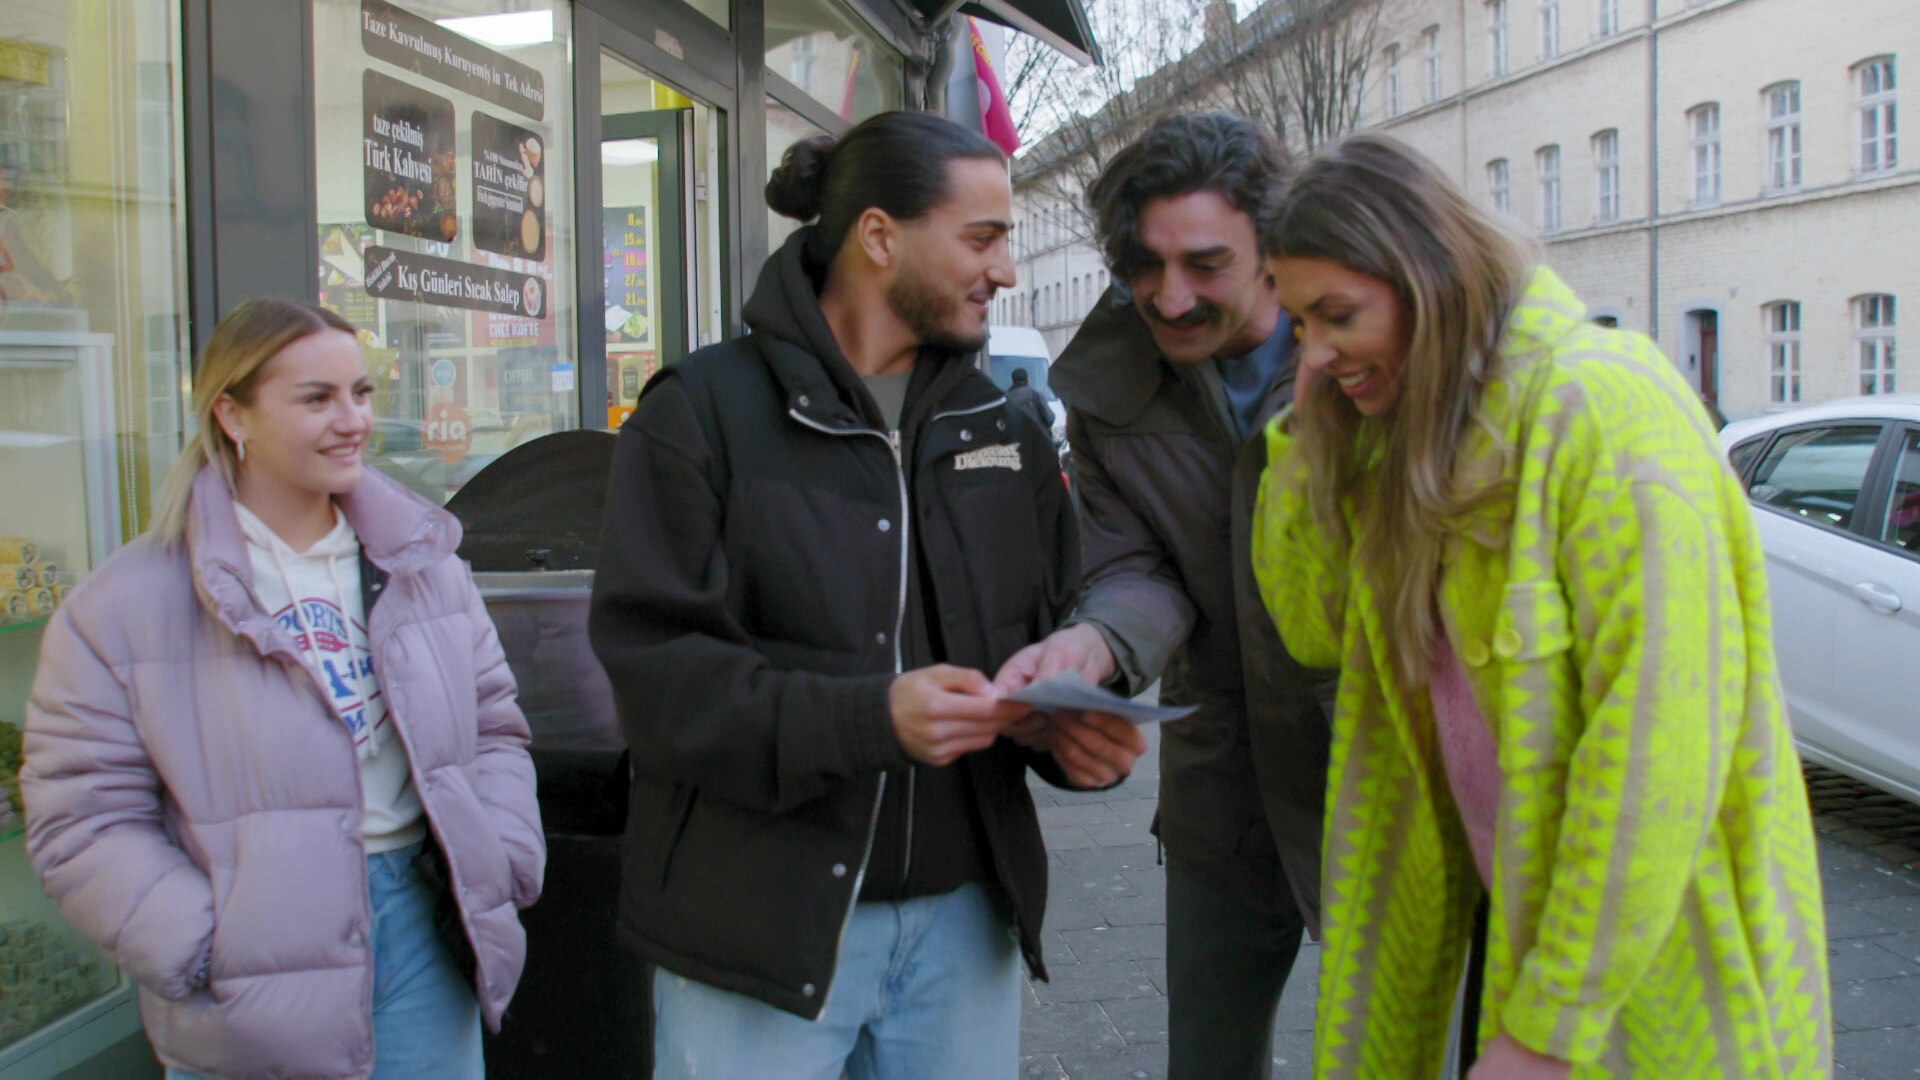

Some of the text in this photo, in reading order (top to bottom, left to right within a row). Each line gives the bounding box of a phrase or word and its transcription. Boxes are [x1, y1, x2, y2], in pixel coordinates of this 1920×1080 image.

[363, 11, 387, 37] Taze
[389, 22, 442, 63] Kavrulmuş
[444, 48, 491, 85] Kuruyemiş
[504, 72, 519, 93] Tek
[520, 82, 544, 104] Adresi
[373, 113, 424, 152] taze çekilmiş
[365, 138, 432, 183] Türk Kahvesi
[398, 265, 418, 295] Kış
[420, 269, 463, 298] Günleri
[464, 275, 492, 301] Sıcak
[494, 282, 520, 311] Salep
[427, 409, 466, 441] ria
